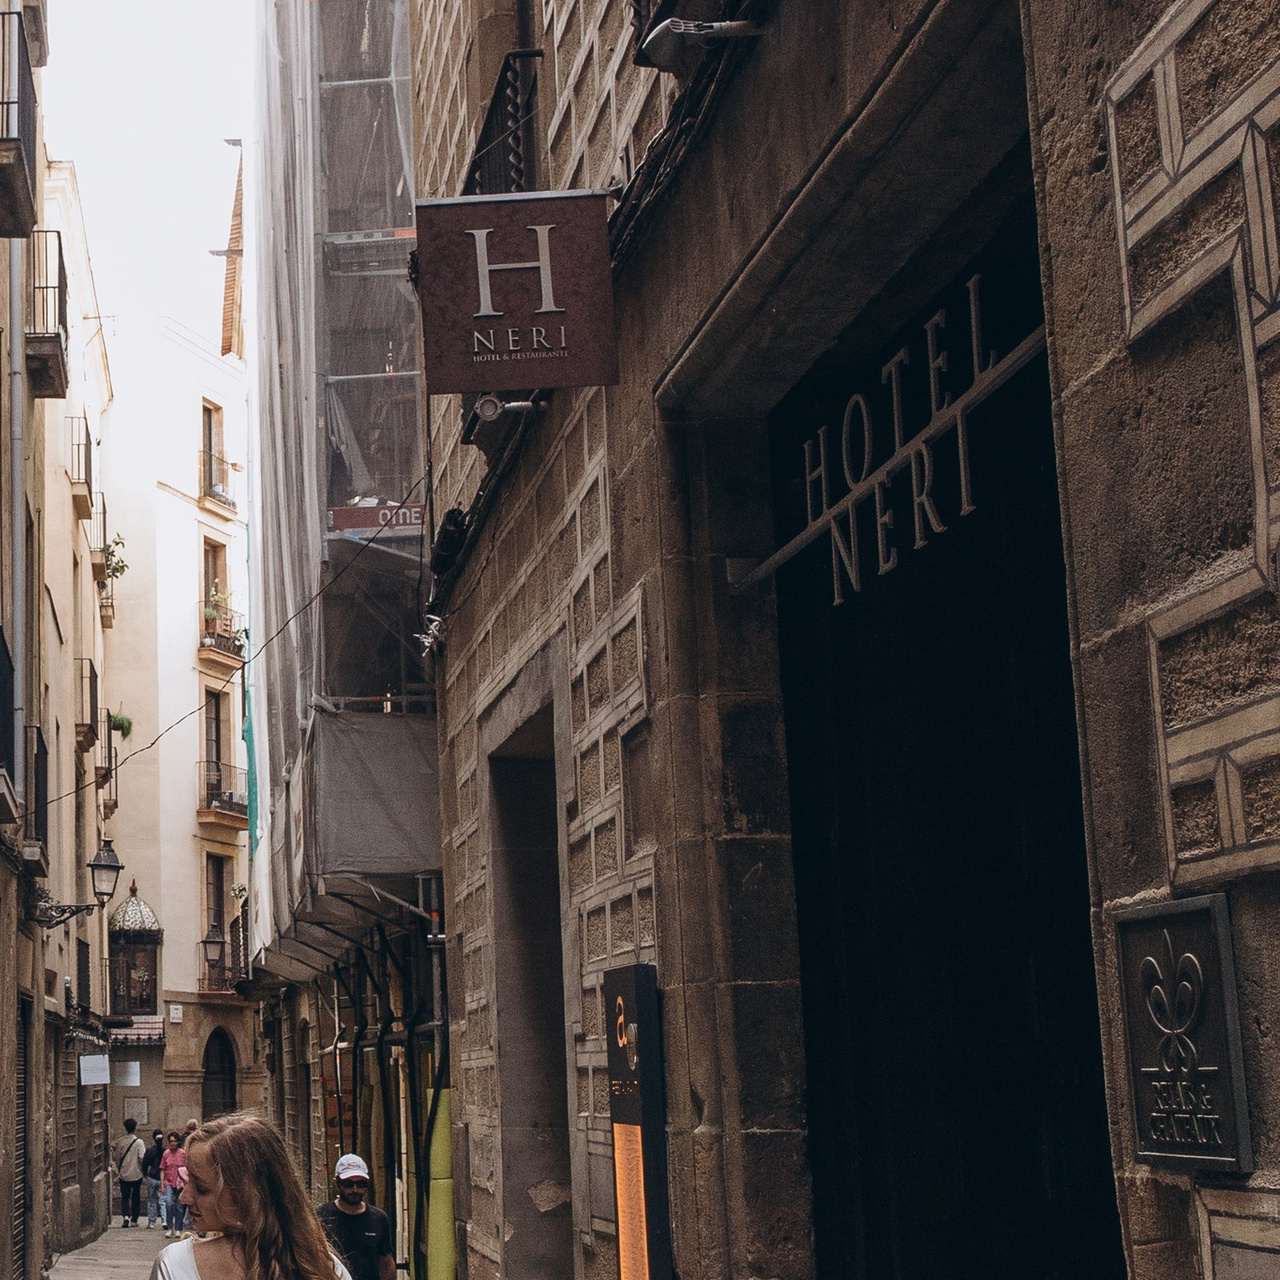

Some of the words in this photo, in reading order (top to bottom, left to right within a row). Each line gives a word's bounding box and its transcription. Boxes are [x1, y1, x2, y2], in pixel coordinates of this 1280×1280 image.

[465, 224, 566, 317] H
[473, 325, 566, 352] NERI
[473, 354, 500, 362] HOTEL
[803, 274, 998, 532] HOTEL
[831, 409, 977, 607] NERI
